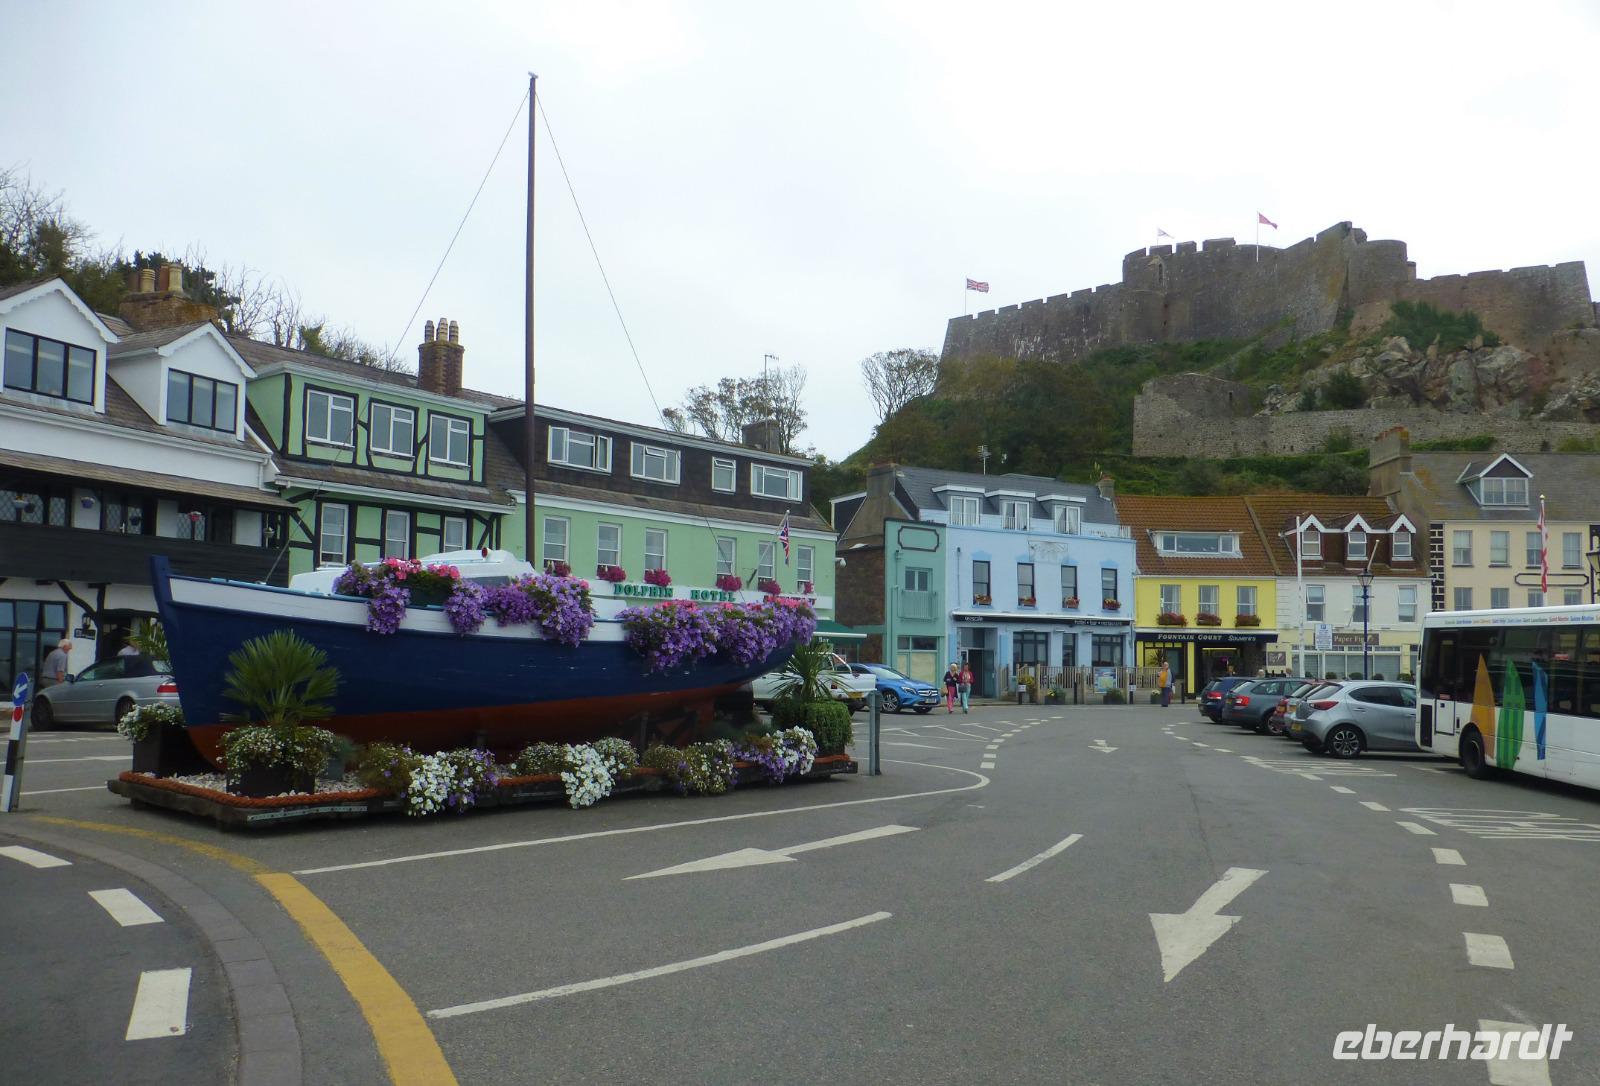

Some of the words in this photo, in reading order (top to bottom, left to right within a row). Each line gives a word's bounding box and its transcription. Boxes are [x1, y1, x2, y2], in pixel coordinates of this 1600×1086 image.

[614, 584, 673, 598] DOLPHIN
[691, 590, 736, 602] HOTEL
[1333, 635, 1352, 644] Paper
